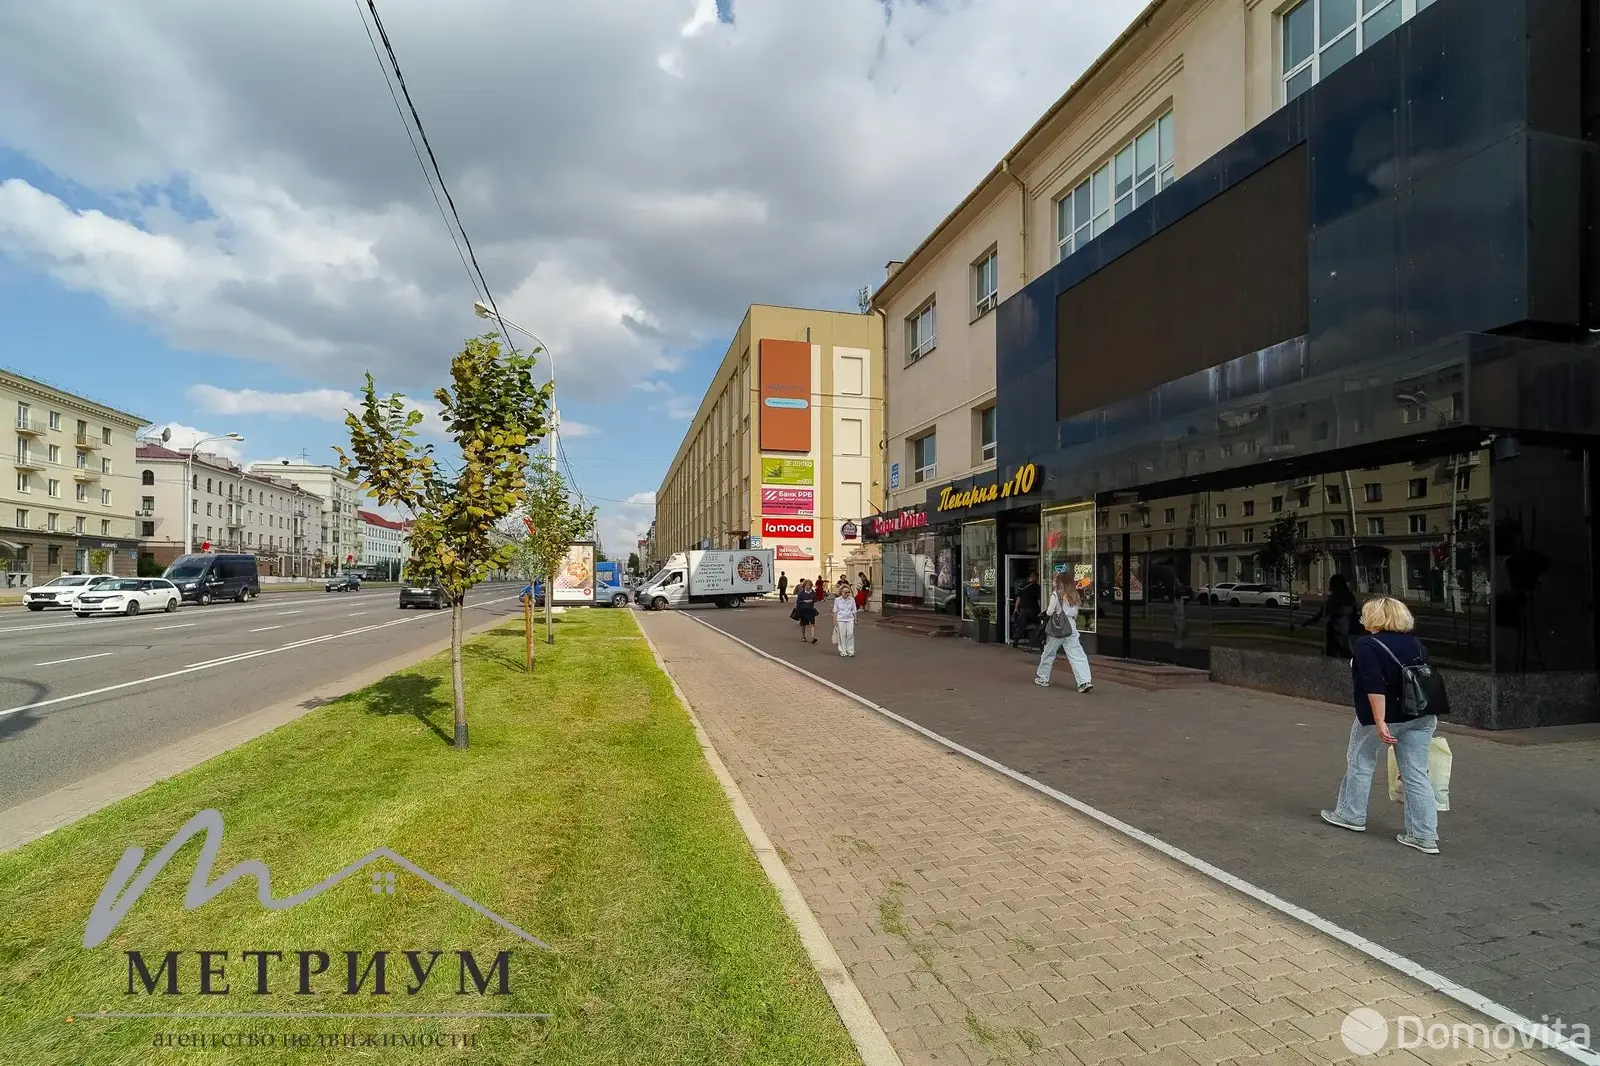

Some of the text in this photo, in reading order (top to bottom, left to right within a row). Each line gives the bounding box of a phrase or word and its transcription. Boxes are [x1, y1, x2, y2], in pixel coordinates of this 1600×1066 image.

[778, 490, 797, 498] Банк
[938, 485, 998, 512] Пекарня
[765, 522, 812, 533] lamoda
[751, 540, 761, 548] 58
